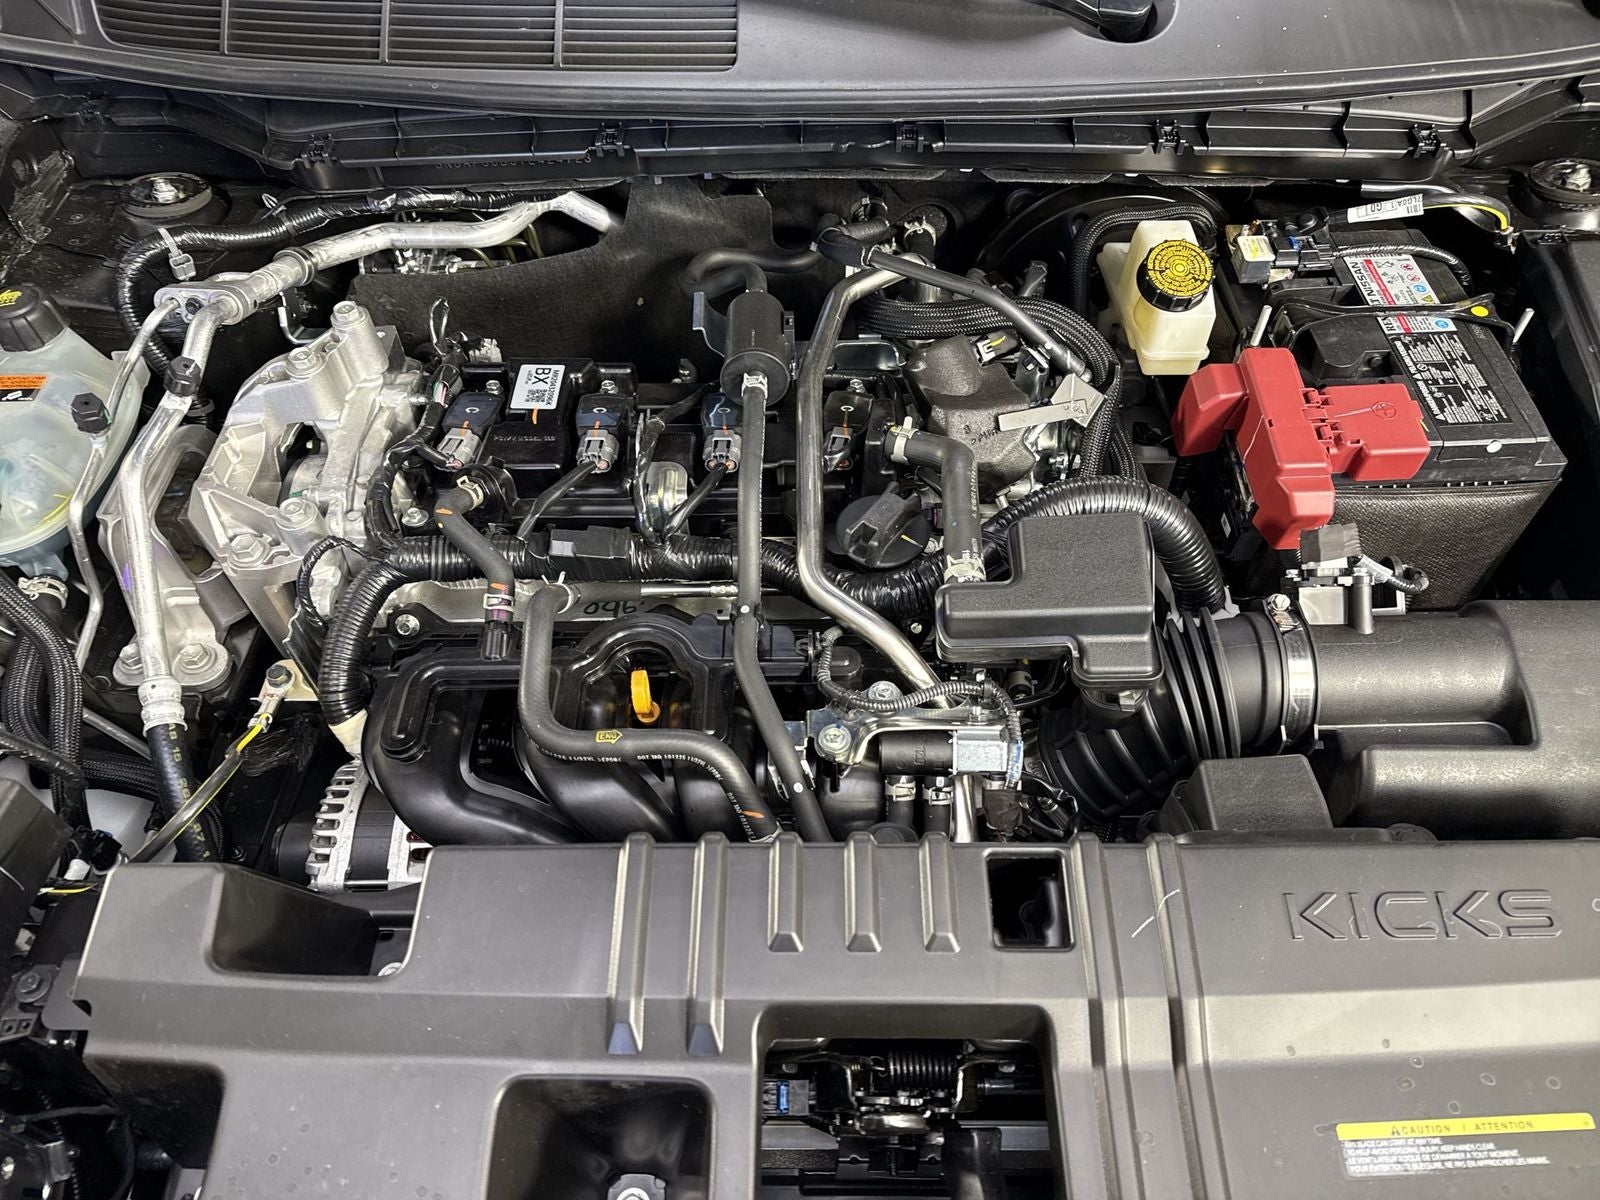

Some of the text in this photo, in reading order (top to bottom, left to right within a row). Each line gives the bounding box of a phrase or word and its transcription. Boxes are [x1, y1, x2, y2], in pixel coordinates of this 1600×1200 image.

[1349, 261, 1378, 297] NISSAN
[531, 367, 552, 385] BX
[599, 733, 618, 741] ENG
[1282, 888, 1562, 940] KICKS
[1401, 1124, 1451, 1135] CAUTION
[1474, 1120, 1534, 1132] ATTENTION
